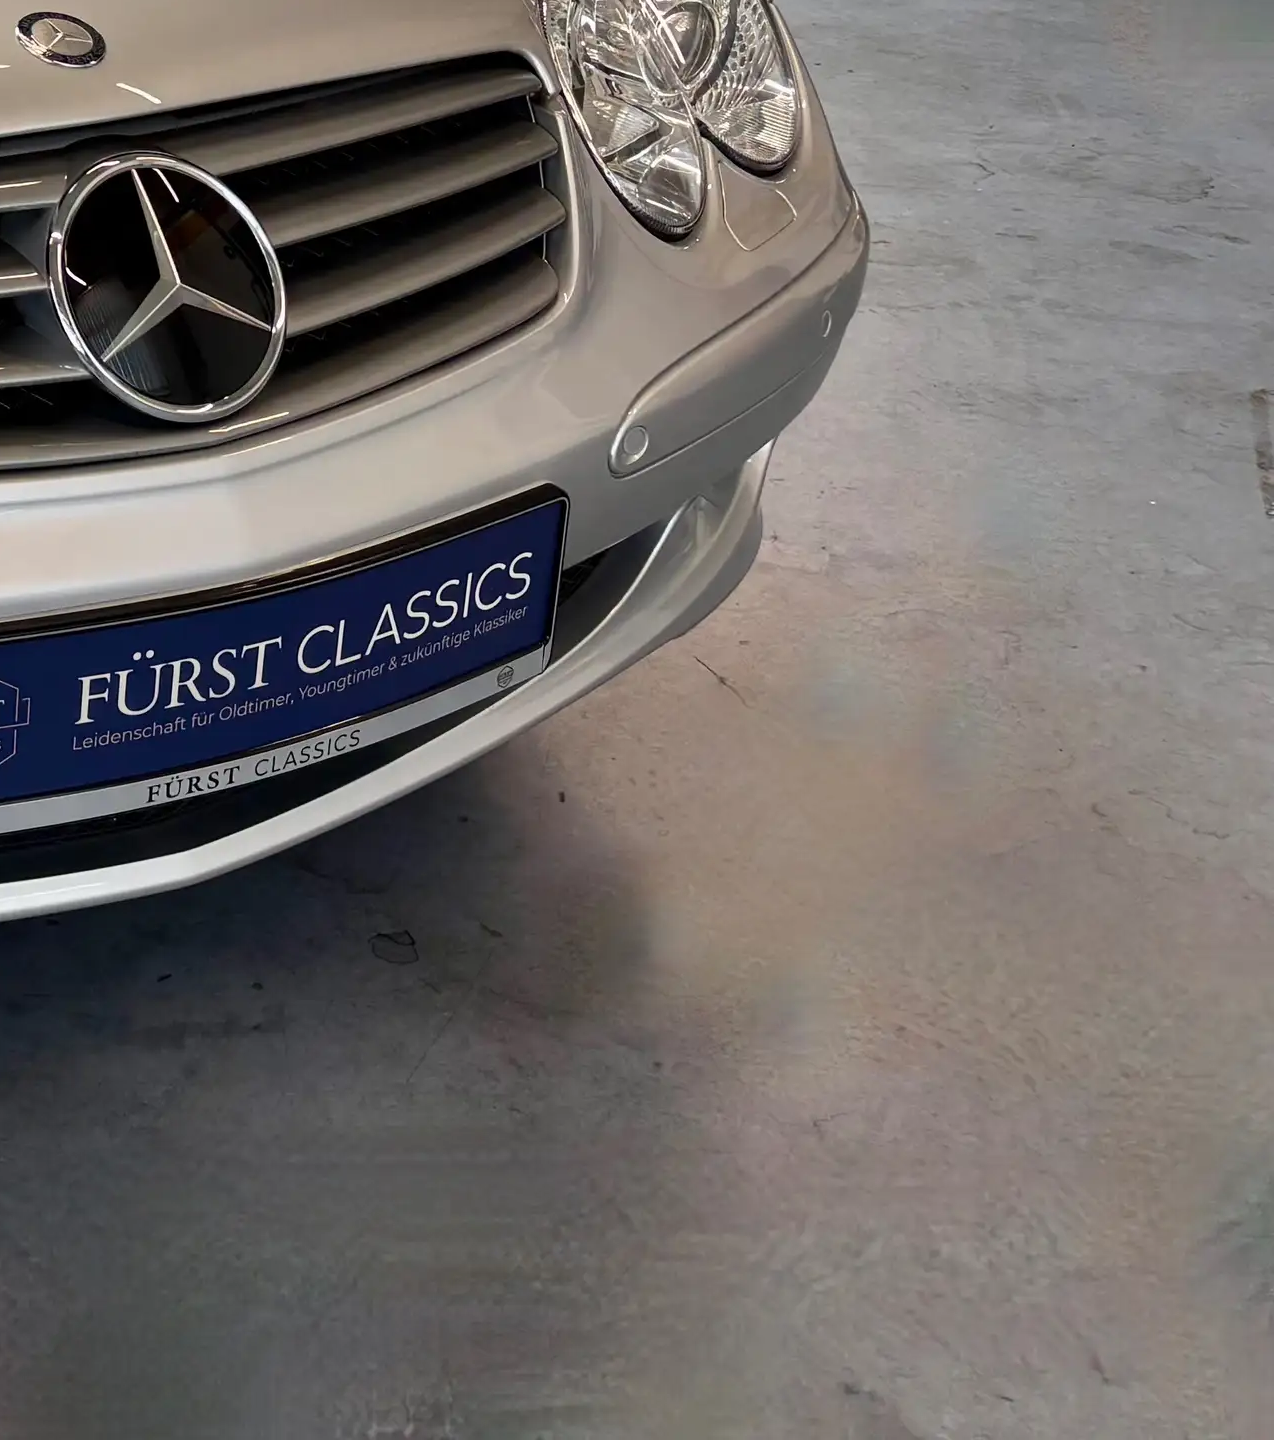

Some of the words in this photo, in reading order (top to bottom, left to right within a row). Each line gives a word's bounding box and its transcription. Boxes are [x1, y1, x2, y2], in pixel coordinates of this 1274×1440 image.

[72, 716, 187, 751] Leidenschaft
[191, 712, 215, 729] für
[218, 691, 295, 722] Oldtimer,
[298, 663, 392, 700] Youngtimer
[387, 656, 398, 671] &
[400, 628, 471, 667] zukünftige
[473, 605, 528, 638] Klassiker
[74, 636, 283, 726] FÜRST
[297, 551, 533, 675] CLASSICS
[146, 765, 240, 804] FÜRST
[254, 729, 361, 777] CLASSICS
